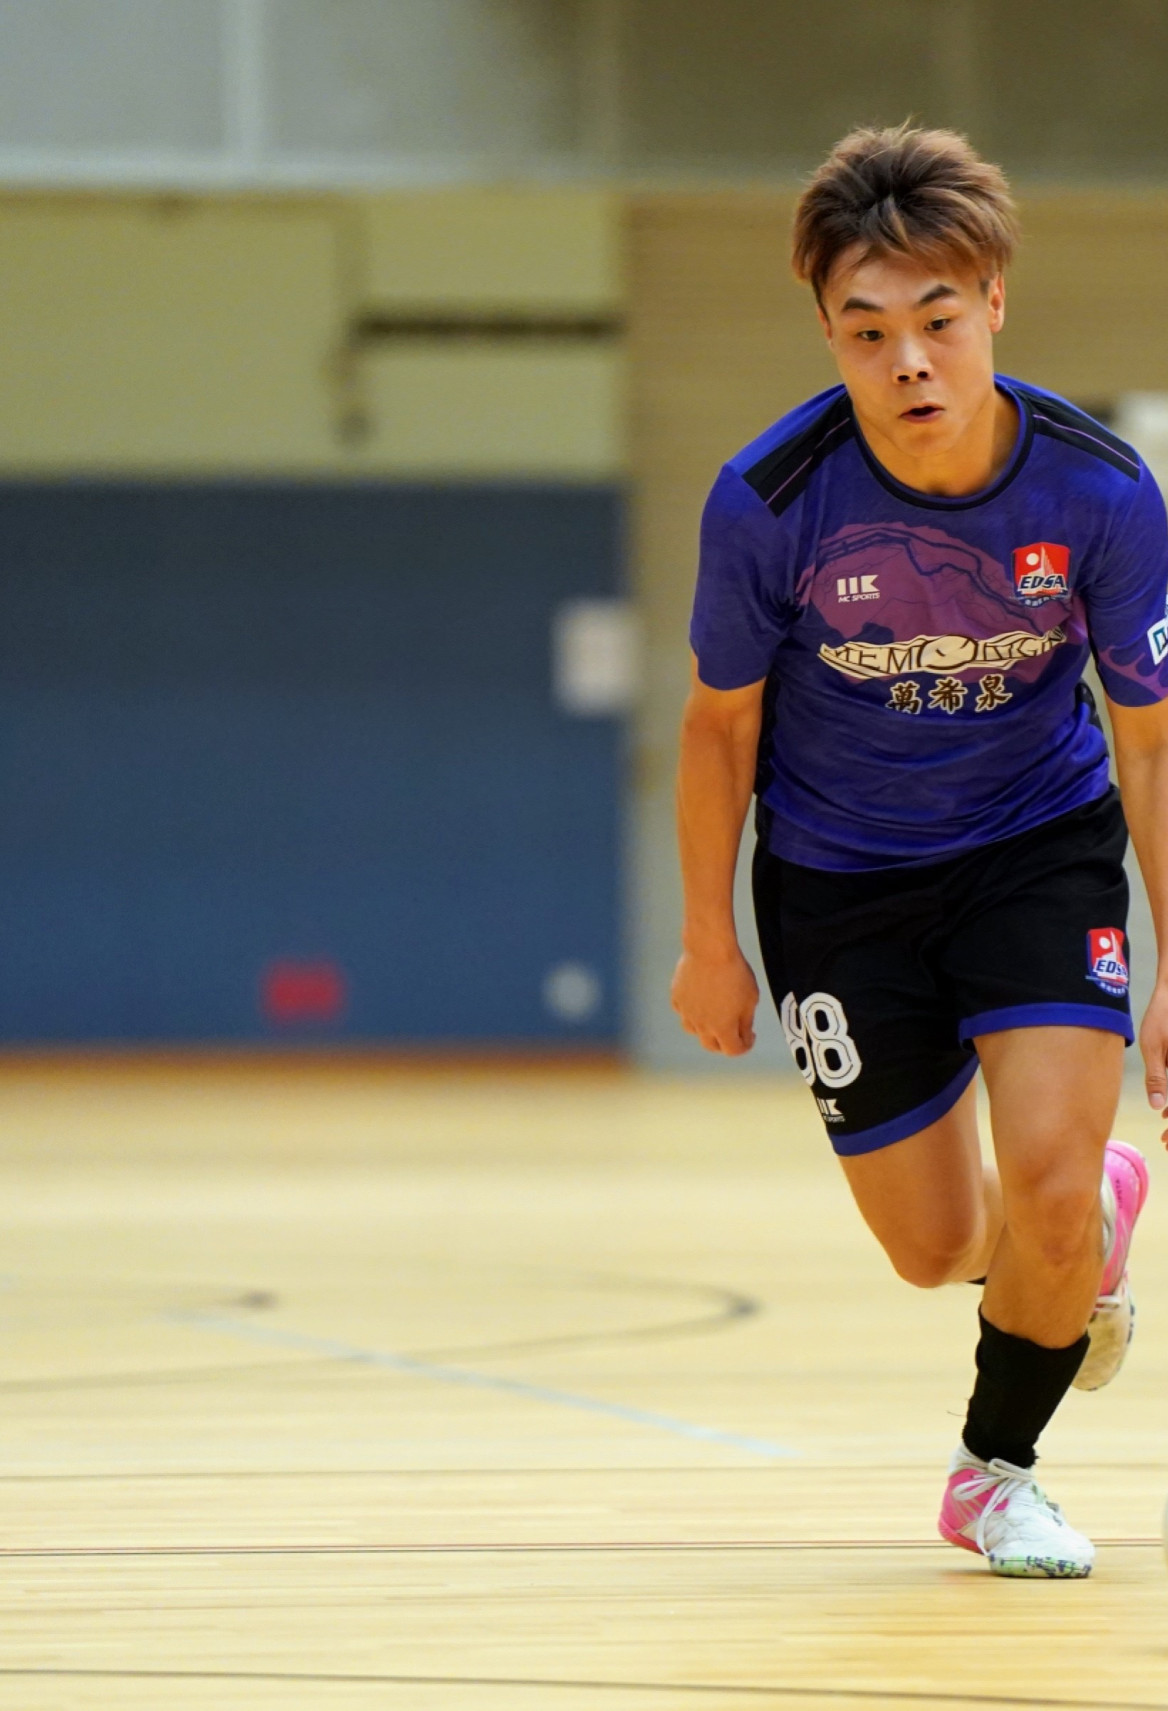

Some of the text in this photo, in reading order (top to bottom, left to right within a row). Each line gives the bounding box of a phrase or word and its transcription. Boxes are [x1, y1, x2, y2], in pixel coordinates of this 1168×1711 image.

[1019, 575, 1066, 590] EDSA
[852, 592, 881, 602] SPORTS
[886, 674, 1013, 715] 萬希泉
